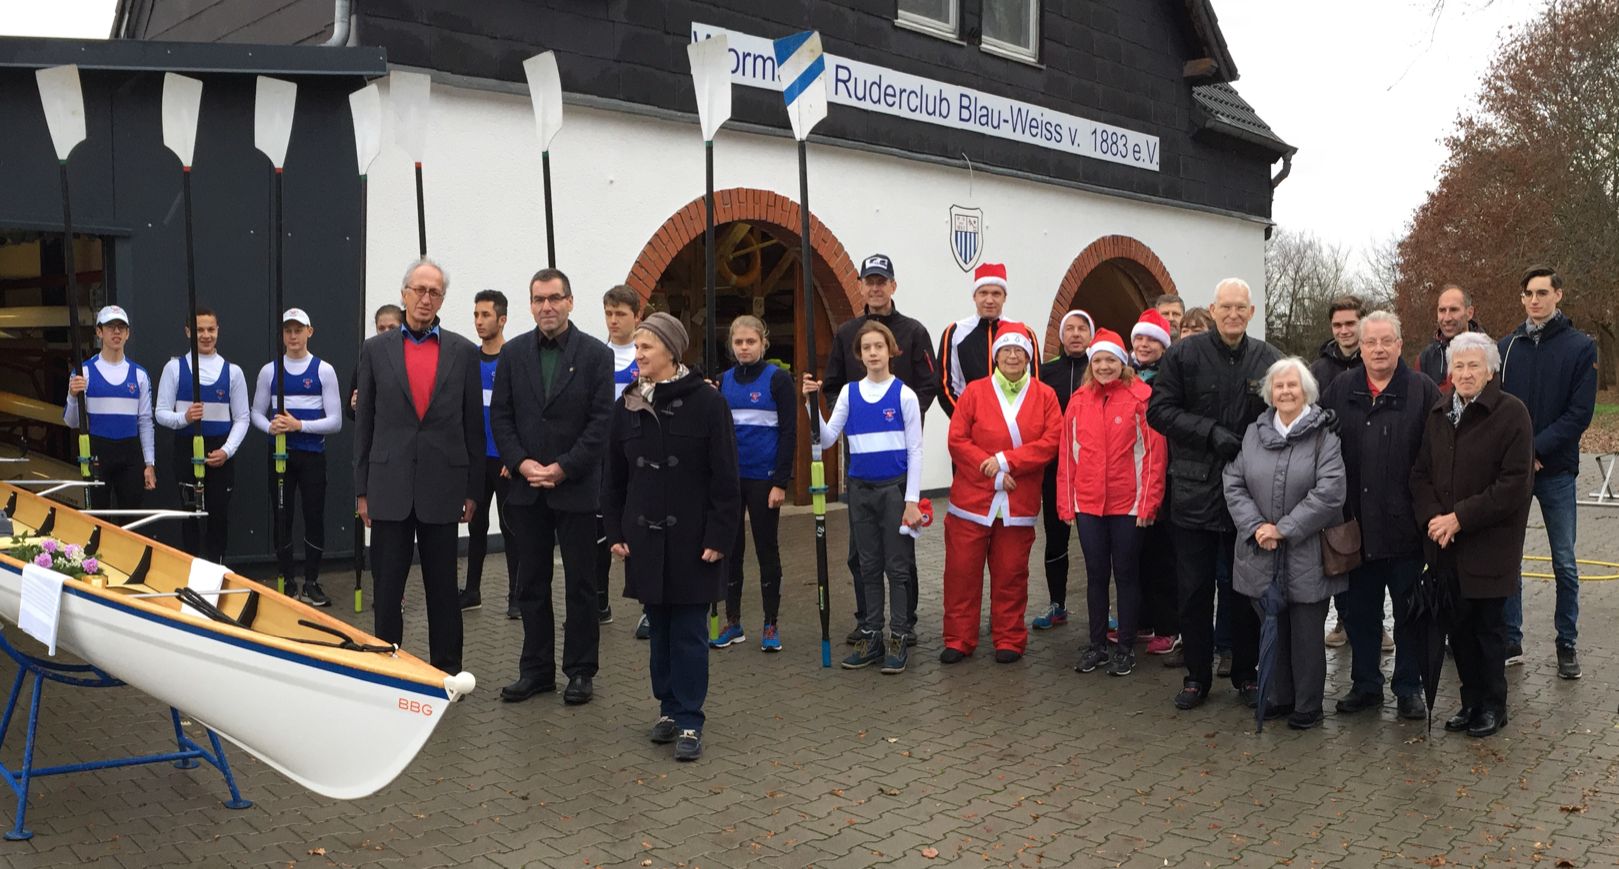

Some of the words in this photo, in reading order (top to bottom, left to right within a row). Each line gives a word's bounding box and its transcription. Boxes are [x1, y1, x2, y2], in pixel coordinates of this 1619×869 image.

[835, 64, 950, 119] Ruderclub
[959, 93, 1062, 144] Blau-Weiss
[1068, 127, 1080, 148] v.
[1091, 127, 1128, 159] 1883
[1132, 139, 1159, 165] e.V.
[398, 697, 433, 717] BBG
